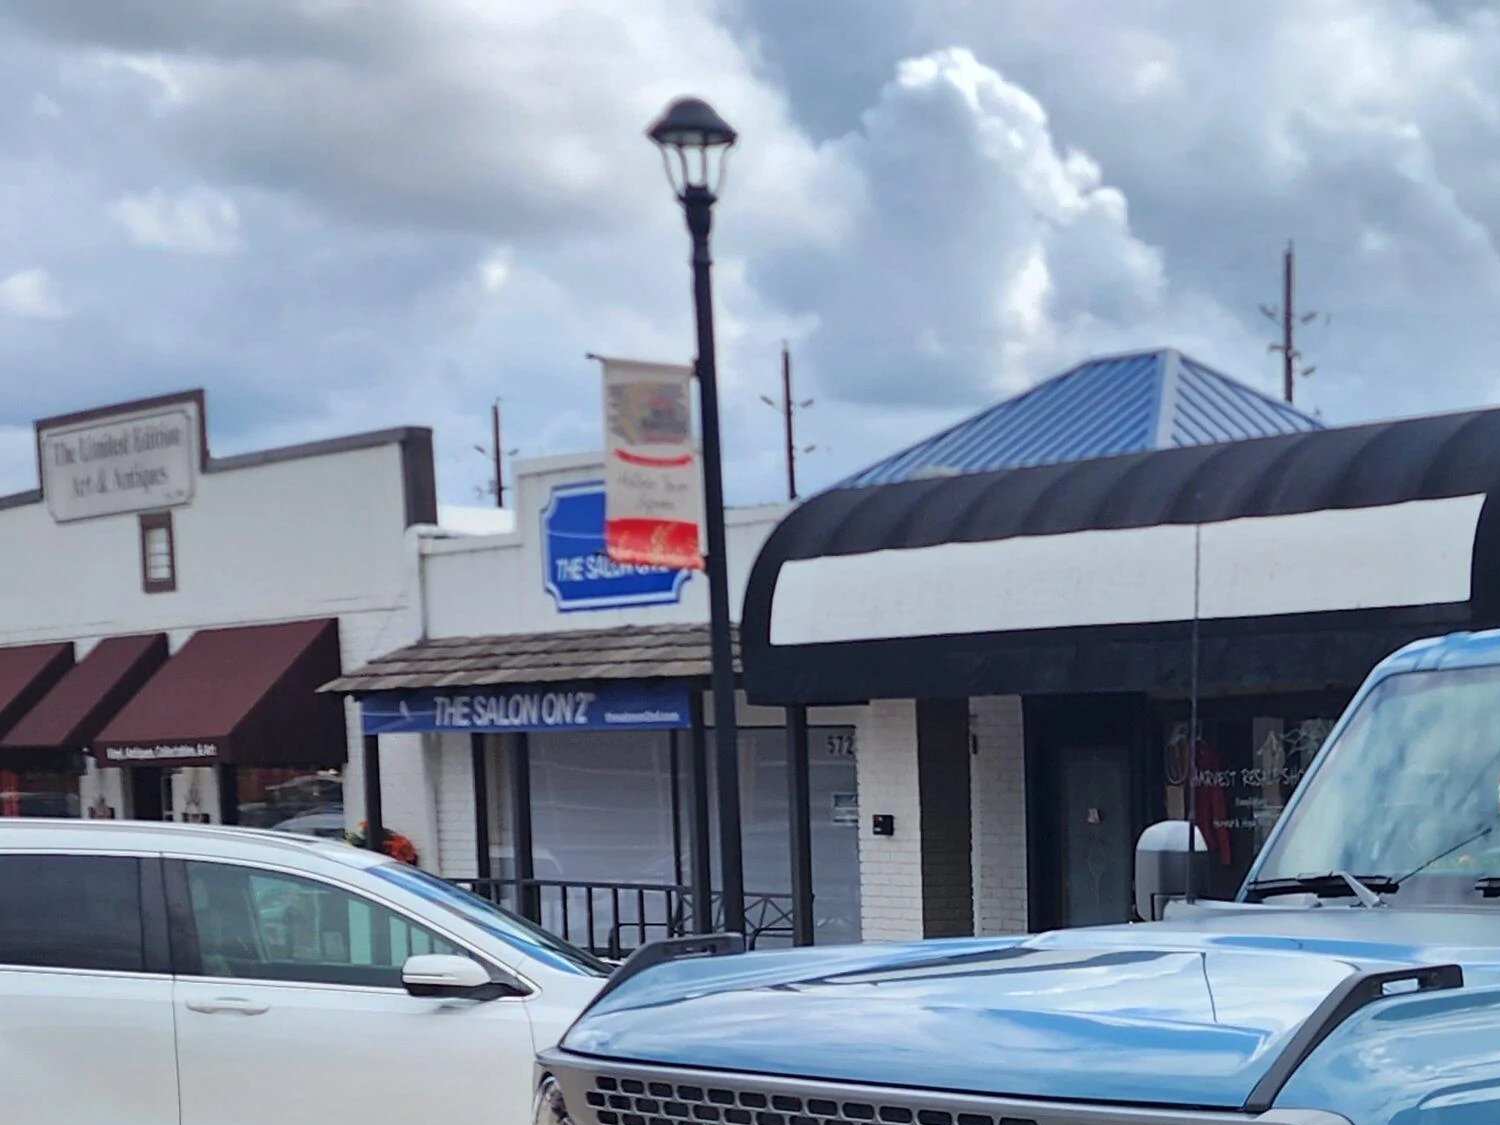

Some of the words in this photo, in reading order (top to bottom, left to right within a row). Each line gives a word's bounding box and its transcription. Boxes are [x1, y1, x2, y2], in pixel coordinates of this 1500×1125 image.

[114, 463, 168, 493] Antiques
[556, 556, 584, 582] THE
[433, 695, 470, 727] THE
[472, 694, 540, 727] SALON
[542, 692, 573, 725] ON
[827, 735, 854, 756] 572
